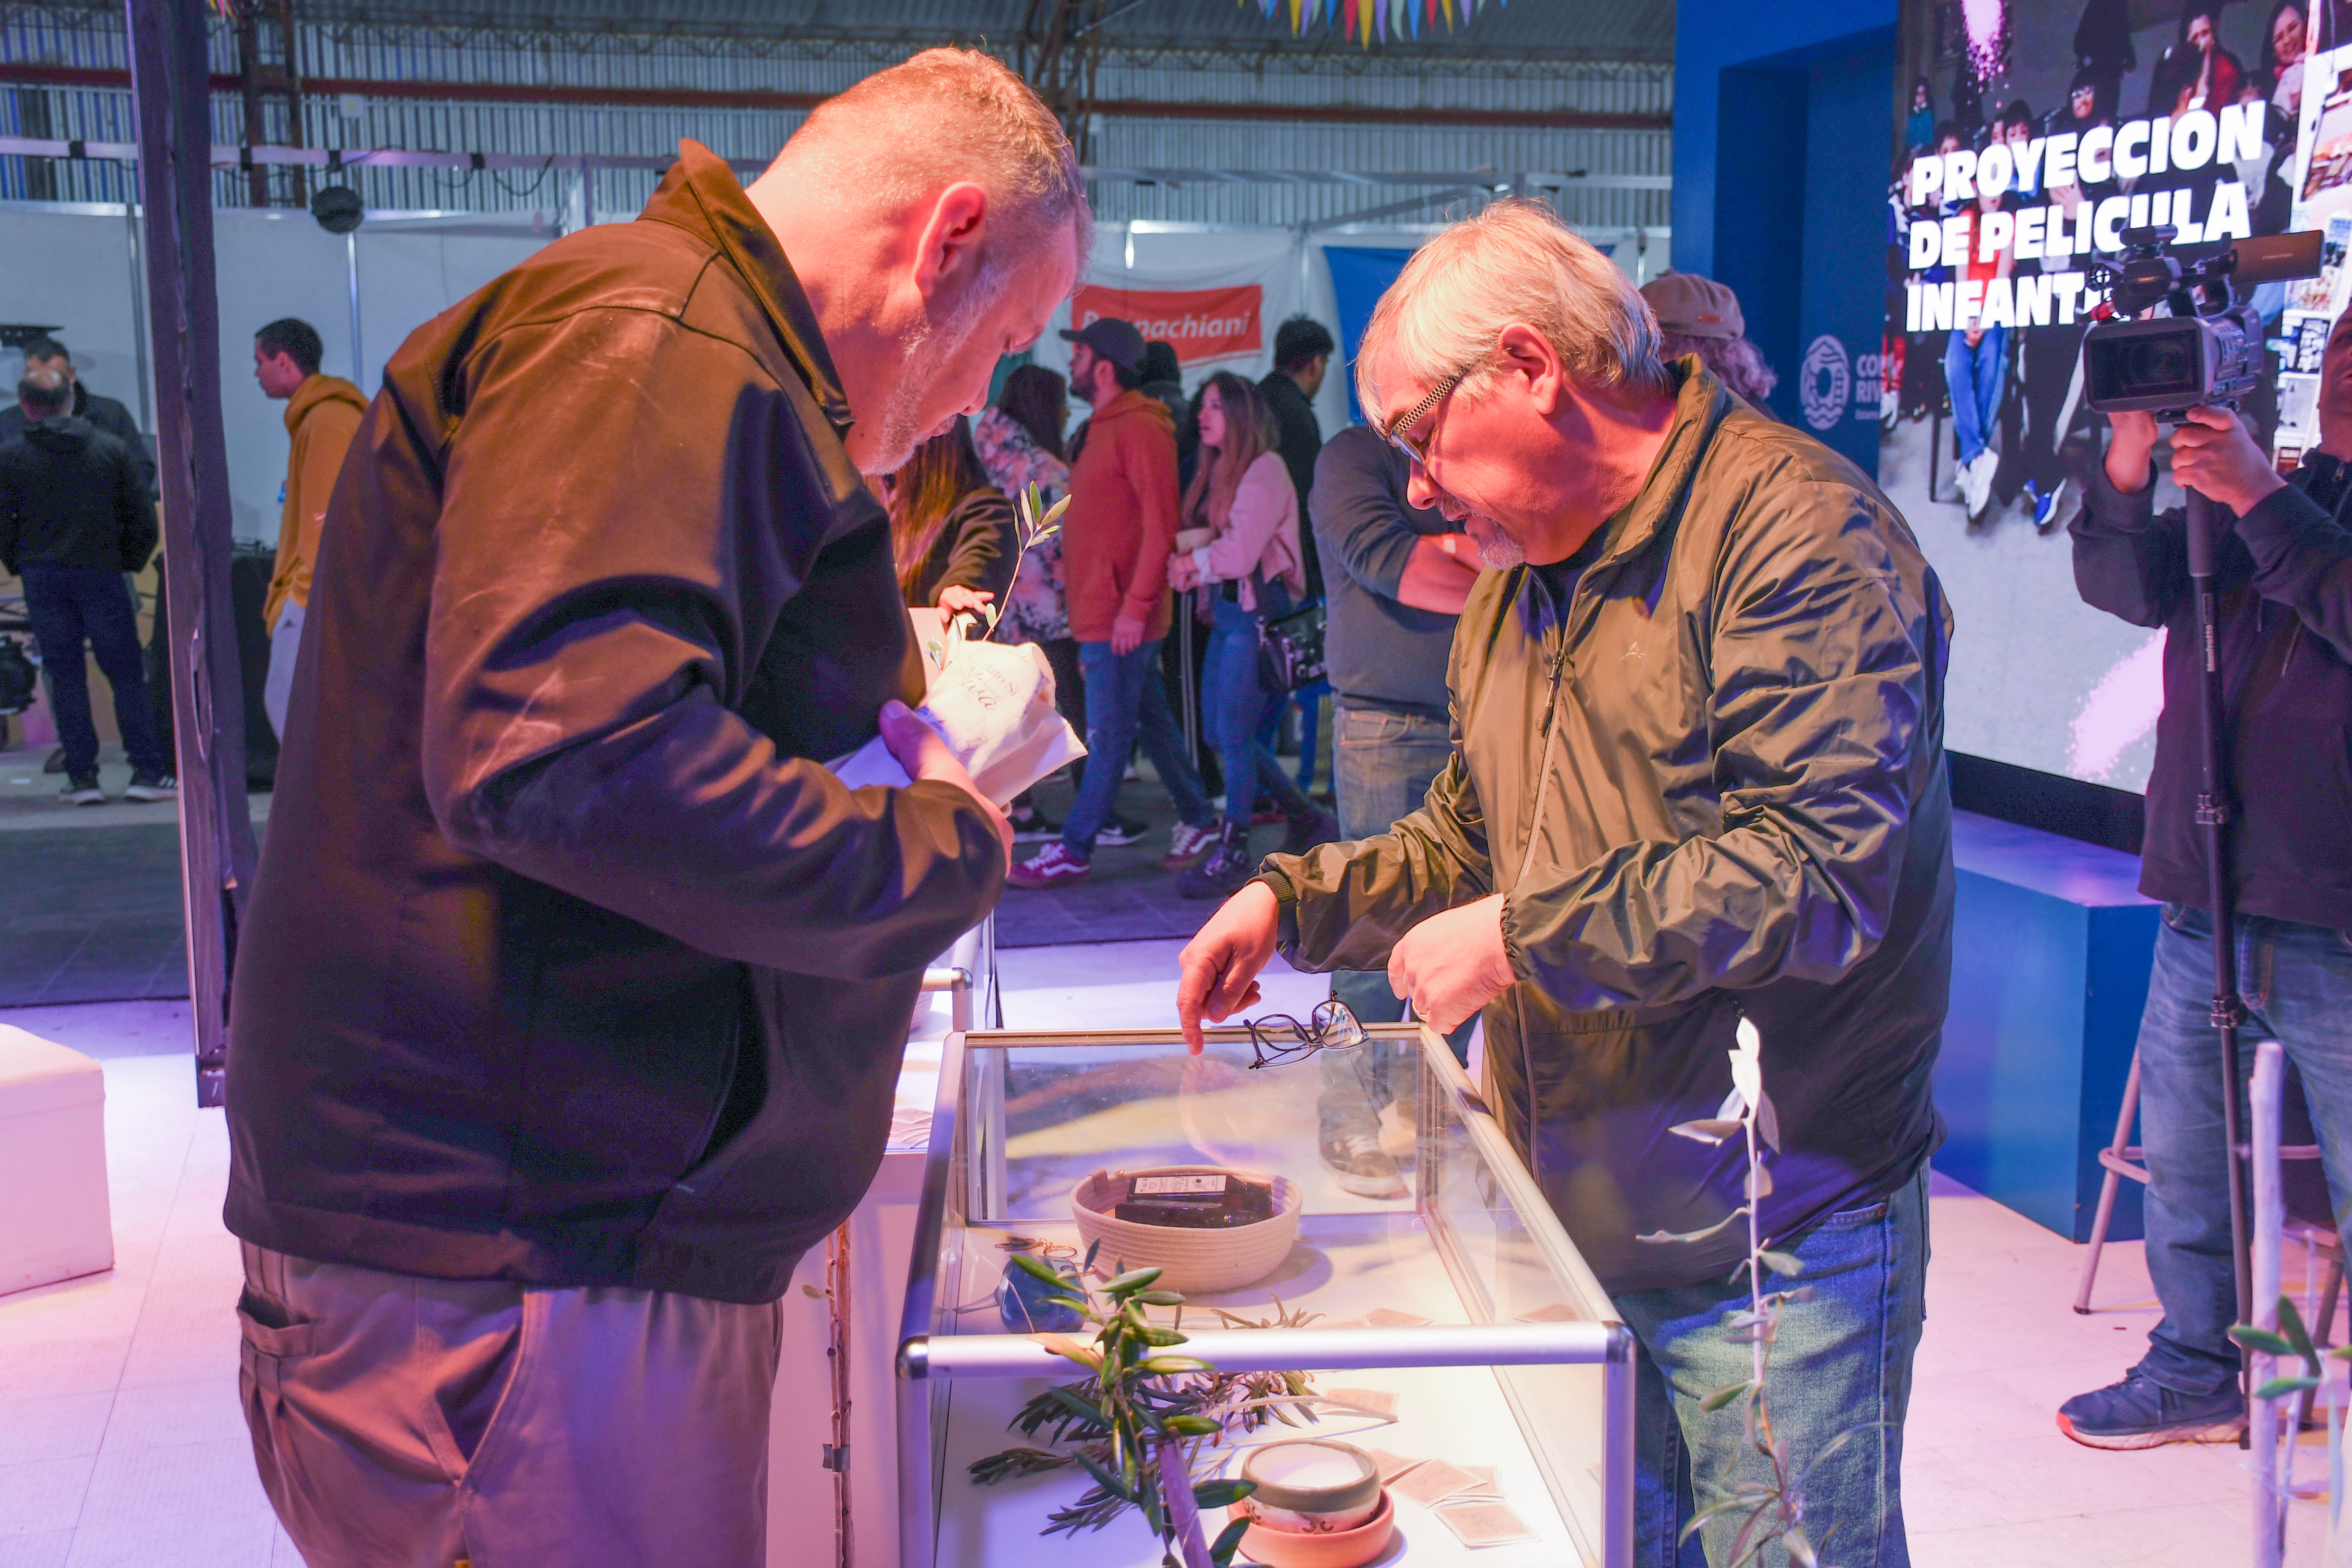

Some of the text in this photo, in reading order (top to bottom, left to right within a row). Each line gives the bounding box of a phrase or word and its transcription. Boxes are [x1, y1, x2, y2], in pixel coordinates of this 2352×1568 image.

[1911, 96, 2266, 207] PROYECCIÓN
[1909, 216, 1971, 270] DE
[1906, 271, 2131, 332] INFANT
